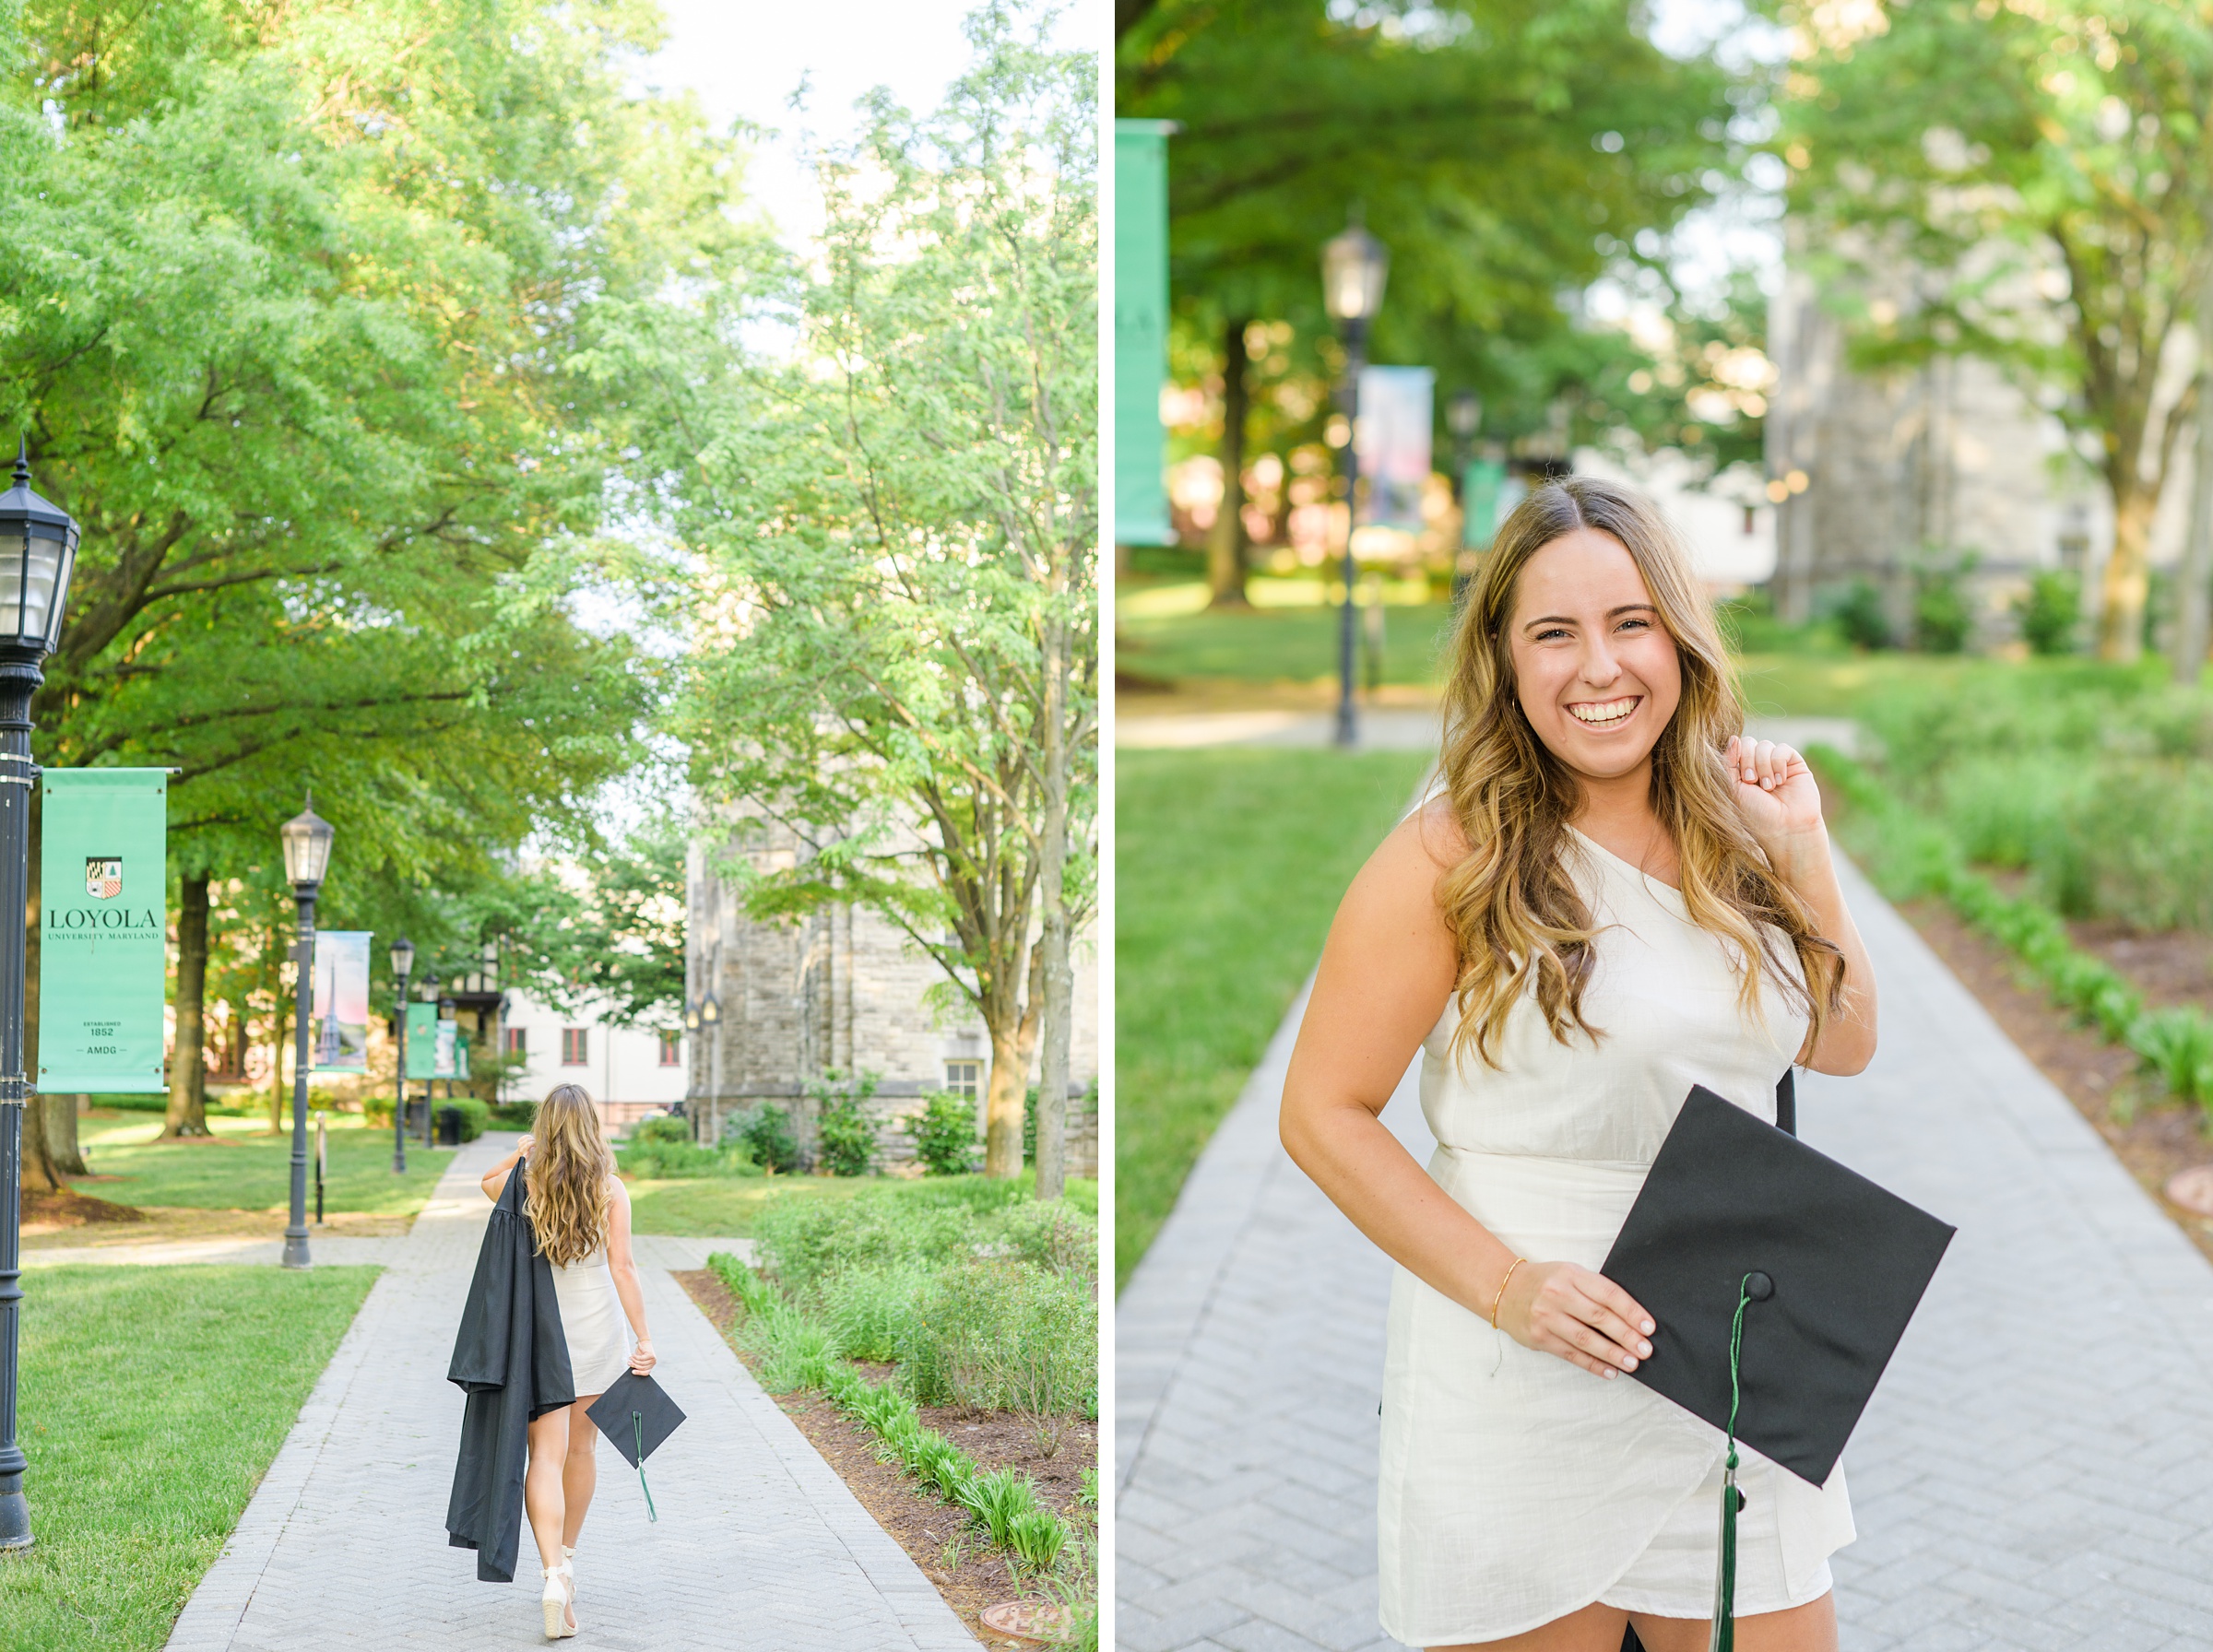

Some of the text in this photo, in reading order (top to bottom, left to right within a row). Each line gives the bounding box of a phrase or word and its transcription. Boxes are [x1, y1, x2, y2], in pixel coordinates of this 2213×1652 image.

[49, 908, 157, 929] LOYOLA
[90, 1028, 113, 1036] 1852
[87, 1046, 117, 1055] AMDG
